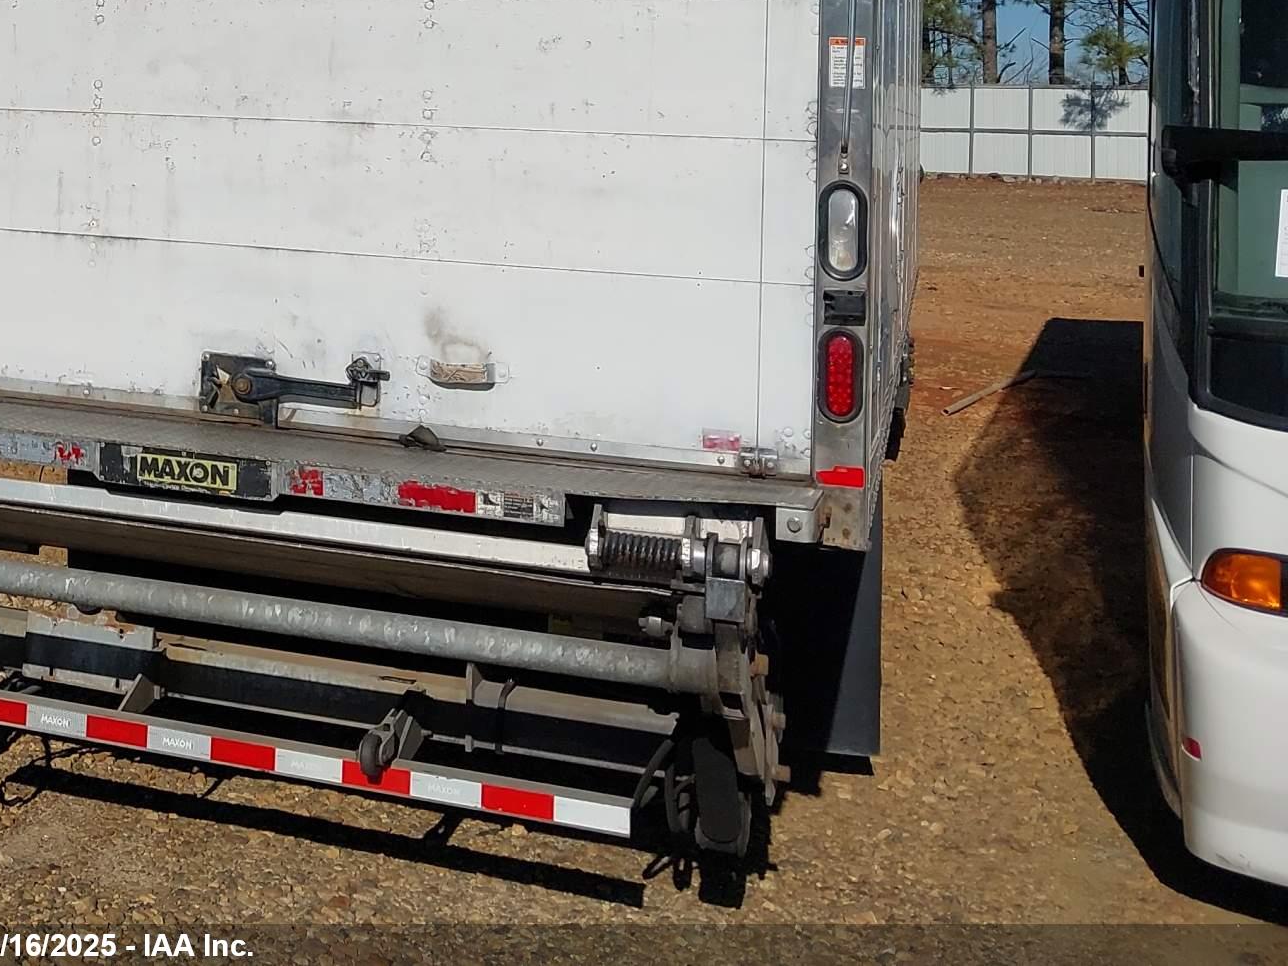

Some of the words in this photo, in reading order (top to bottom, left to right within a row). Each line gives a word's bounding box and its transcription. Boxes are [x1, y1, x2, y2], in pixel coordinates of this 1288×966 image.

[139, 456, 230, 487] MAXON
[40, 713, 69, 729] MAXON
[162, 737, 193, 750] MAXON
